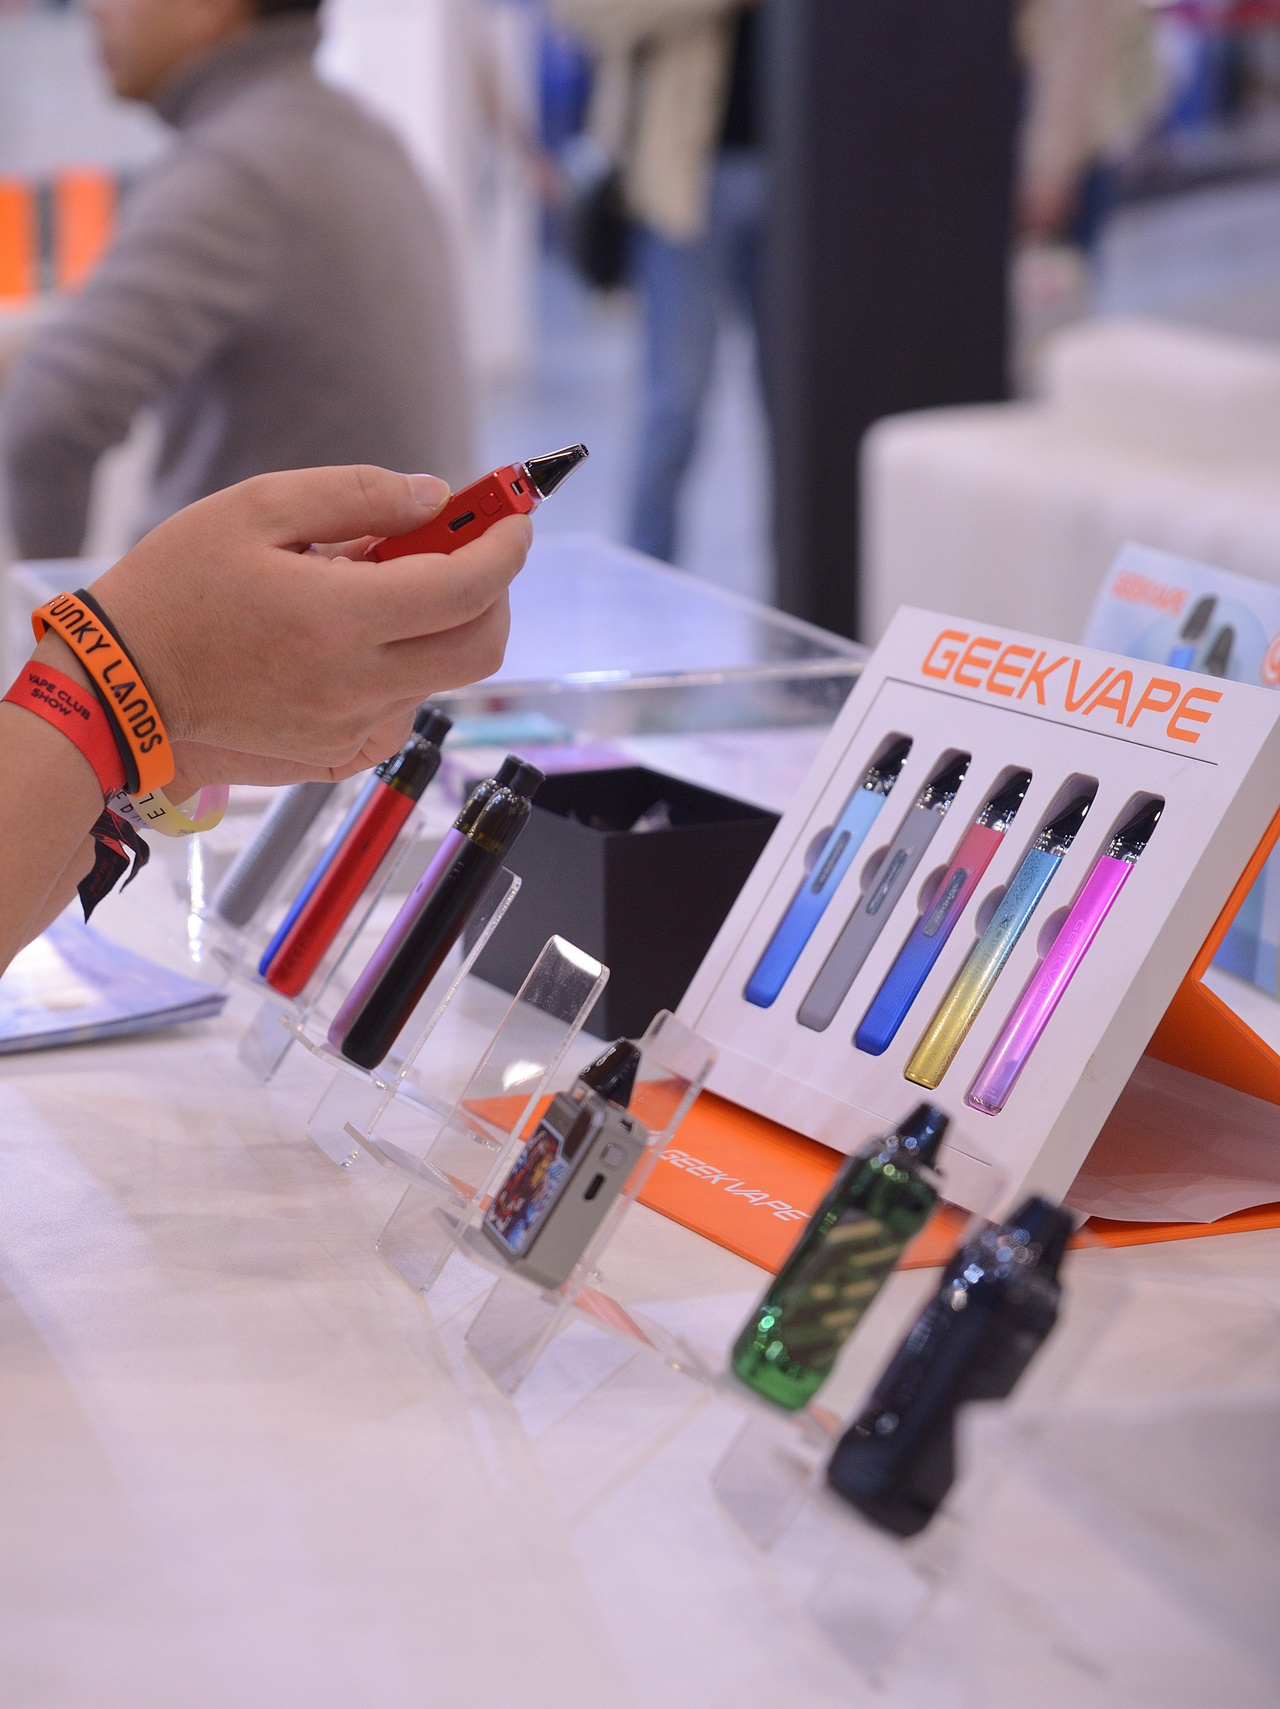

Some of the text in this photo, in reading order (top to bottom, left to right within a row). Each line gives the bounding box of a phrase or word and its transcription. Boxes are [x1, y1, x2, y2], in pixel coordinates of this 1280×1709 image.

[28, 673, 91, 720] VAPE CLUB
[31, 688, 72, 716] SHOW
[103, 659, 162, 753] LANDS
[921, 629, 1223, 744] GEEKVAPE
[1030, 919, 1085, 1017] GEEKVAPE
[659, 1149, 811, 1221] GEEKVAPE
